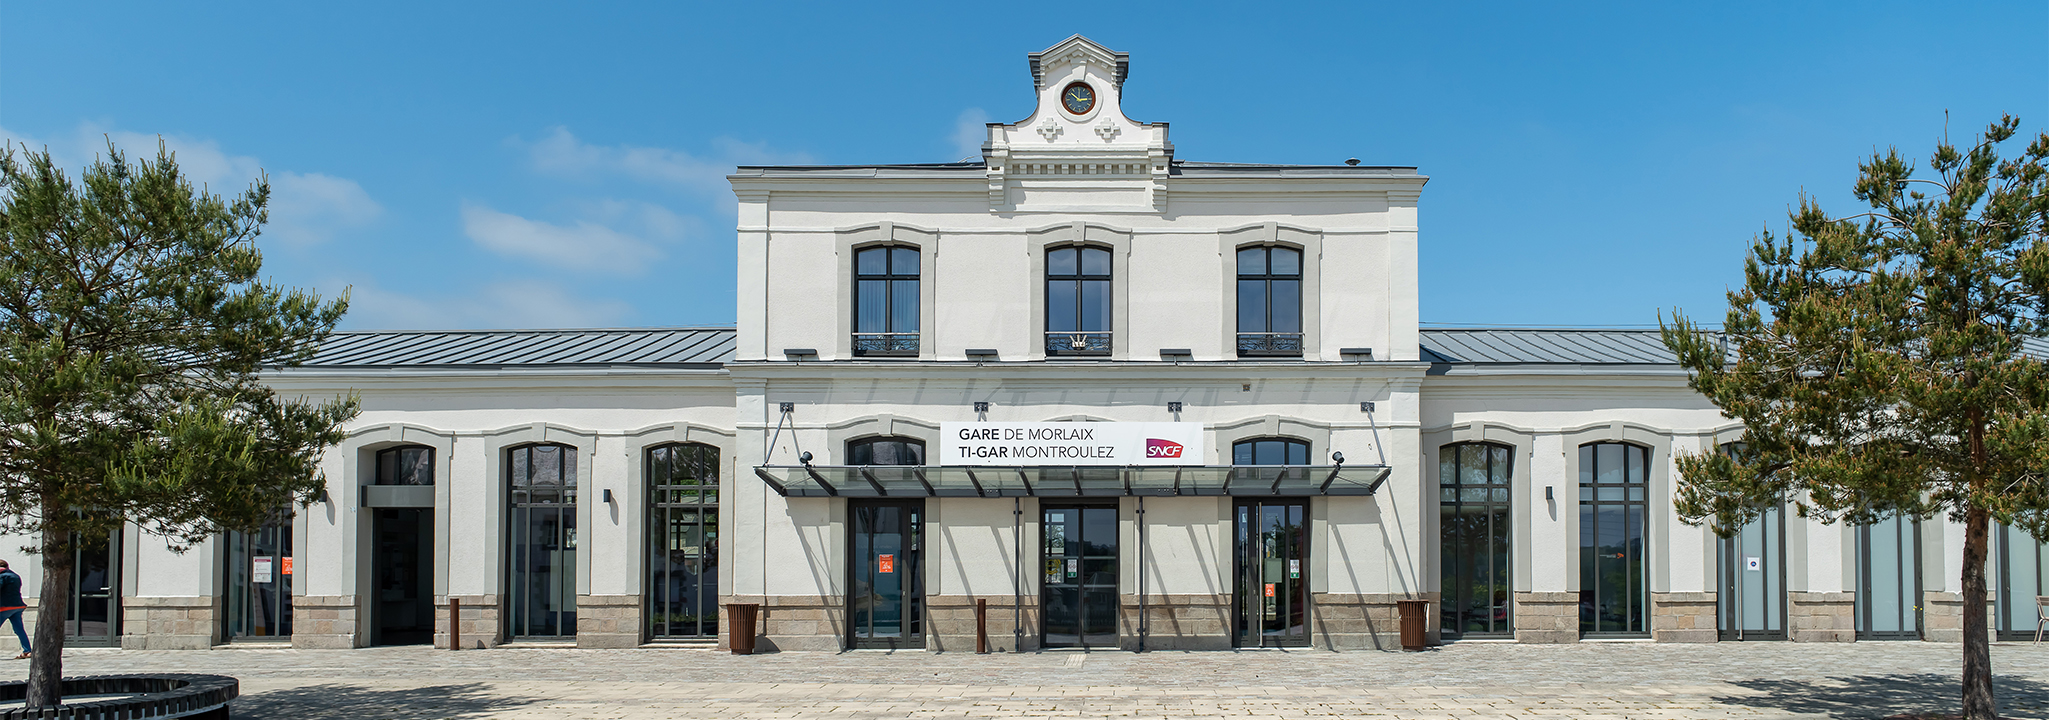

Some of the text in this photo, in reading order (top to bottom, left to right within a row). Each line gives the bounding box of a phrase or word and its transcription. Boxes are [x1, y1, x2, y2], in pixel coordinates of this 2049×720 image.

[959, 428, 1094, 440] GARE DE MORLAIX
[958, 446, 1115, 458] TI-GAR MONTROULEZ
[1147, 445, 1182, 456] SNCF
